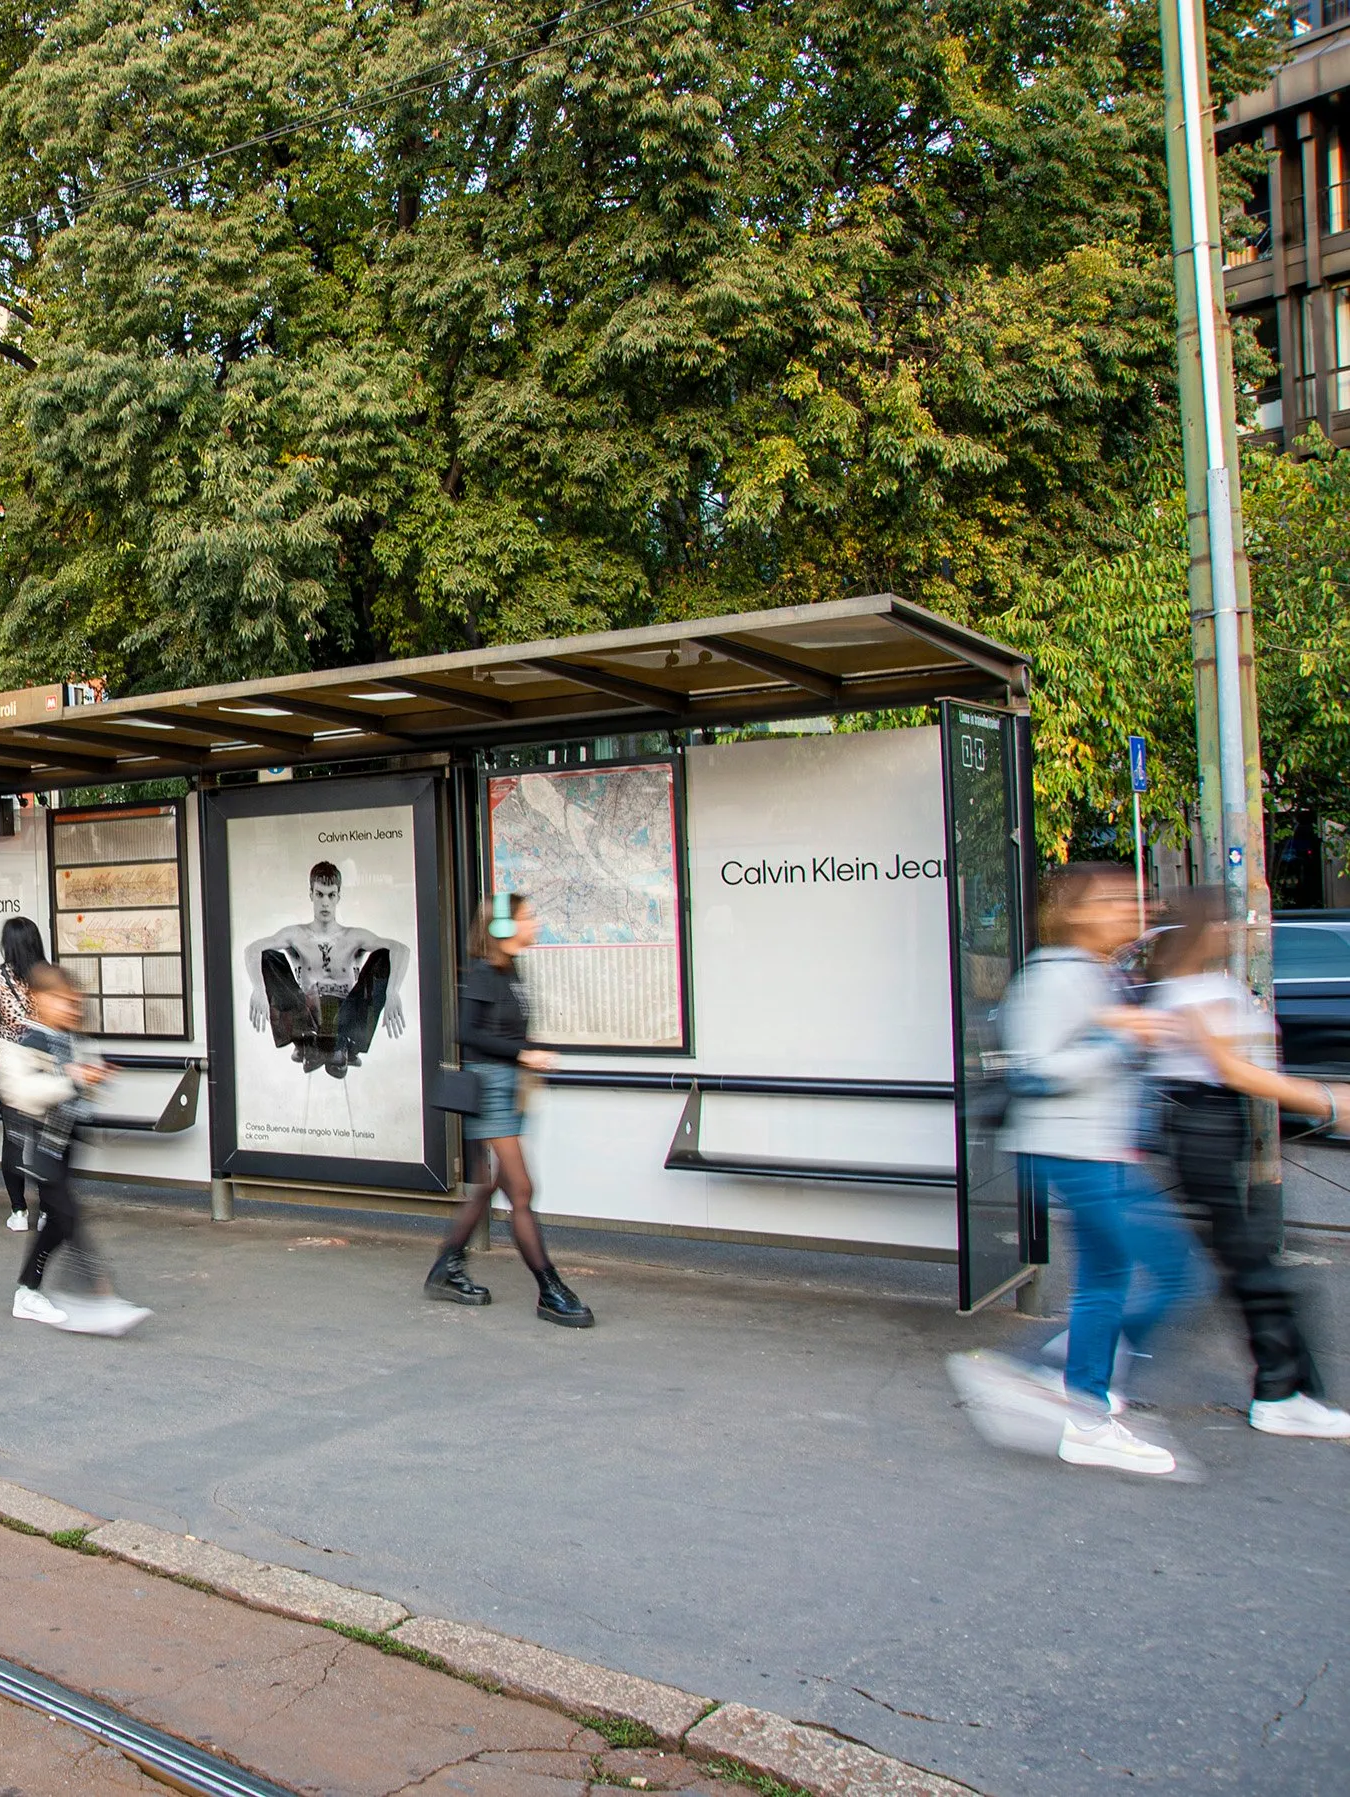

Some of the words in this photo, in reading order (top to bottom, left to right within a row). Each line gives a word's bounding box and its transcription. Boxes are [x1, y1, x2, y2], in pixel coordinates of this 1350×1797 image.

[318, 832, 348, 843] Calvin
[349, 830, 372, 841] Klein
[373, 829, 403, 840] Jeans
[721, 859, 806, 885] Calvin
[812, 856, 879, 882] Klein
[885, 854, 946, 880] Jea
[245, 1122, 266, 1132] Corso
[266, 1123, 290, 1134] Buenos
[291, 1125, 307, 1135] Aires
[308, 1128, 332, 1138] angolo
[332, 1128, 351, 1138] Viale
[351, 1129, 375, 1139] Tunisia
